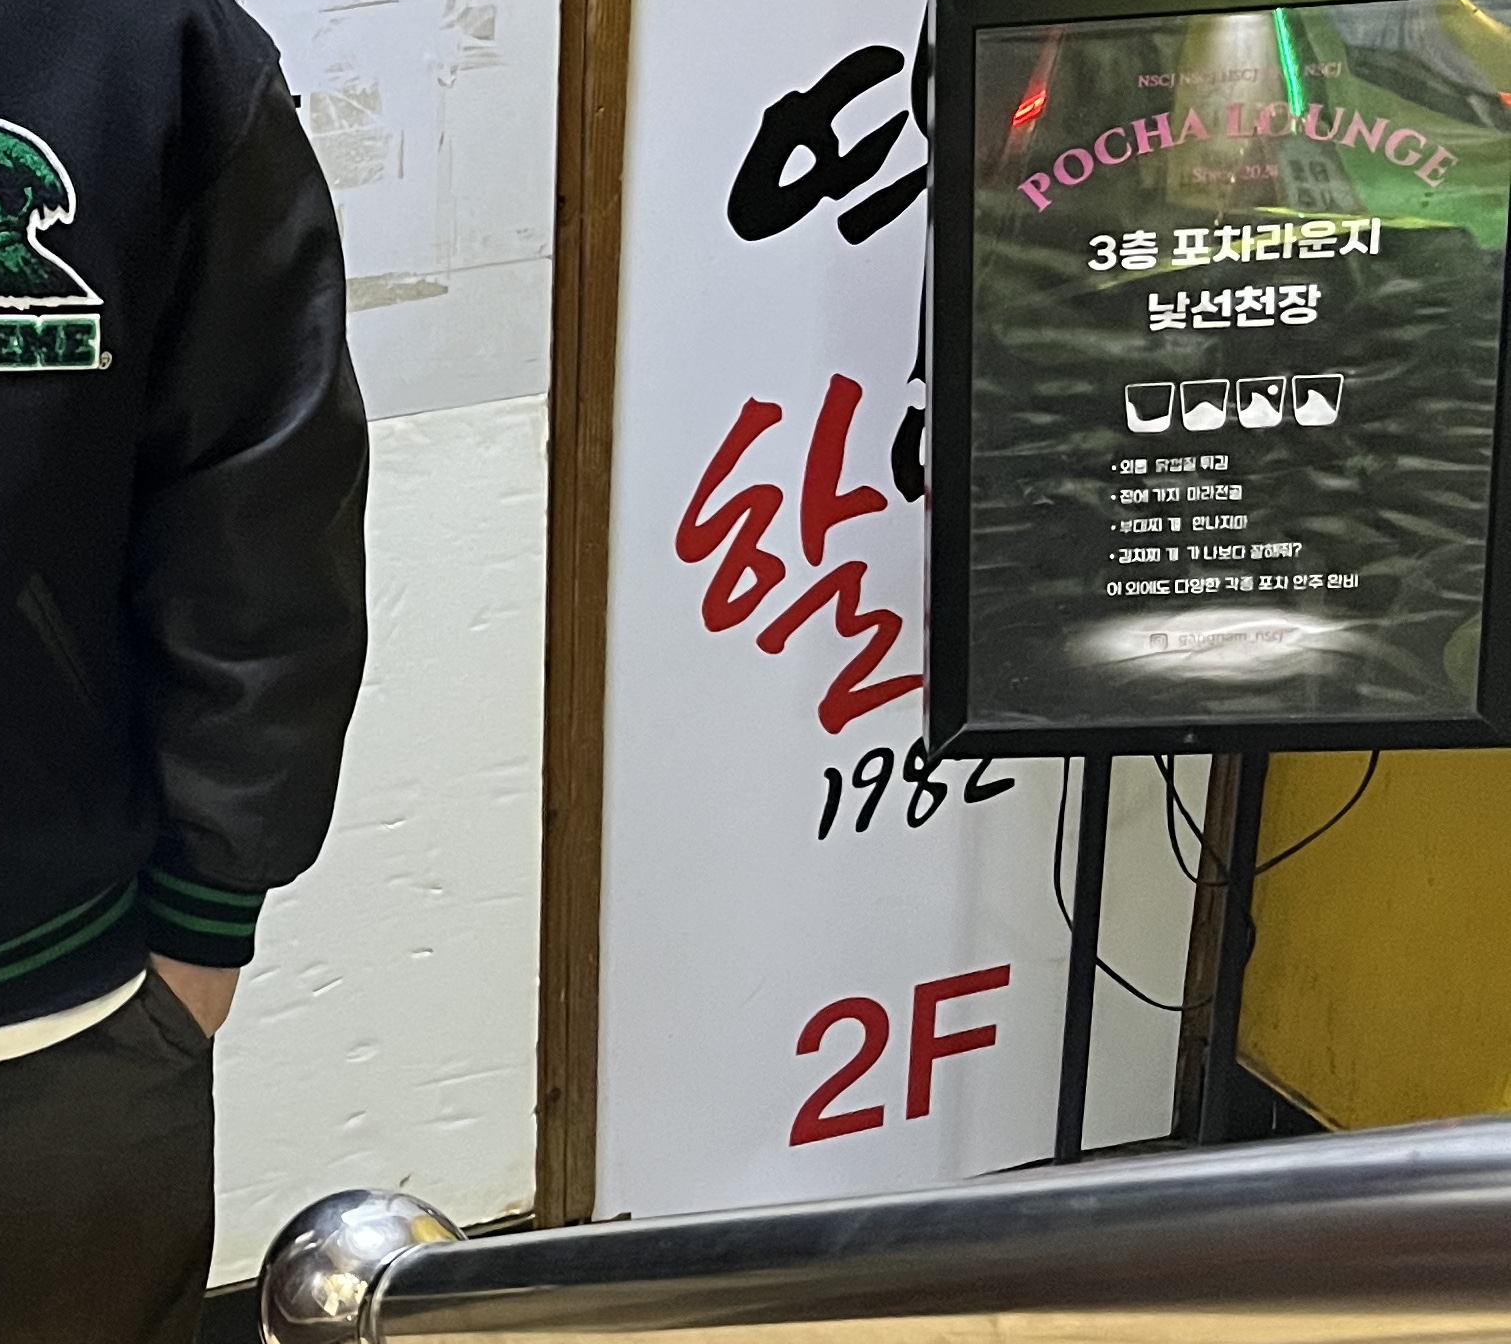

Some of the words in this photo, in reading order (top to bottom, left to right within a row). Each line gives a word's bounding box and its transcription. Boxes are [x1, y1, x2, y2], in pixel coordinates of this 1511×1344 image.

[1017, 107, 1209, 213] POCHA
[1225, 102, 1459, 188] LOUNGE
[1087, 229, 1159, 271] 3층
[1171, 217, 1381, 266] 포차라운지
[1174, 577, 1221, 594] 다양한
[789, 963, 1011, 1146] 2F
